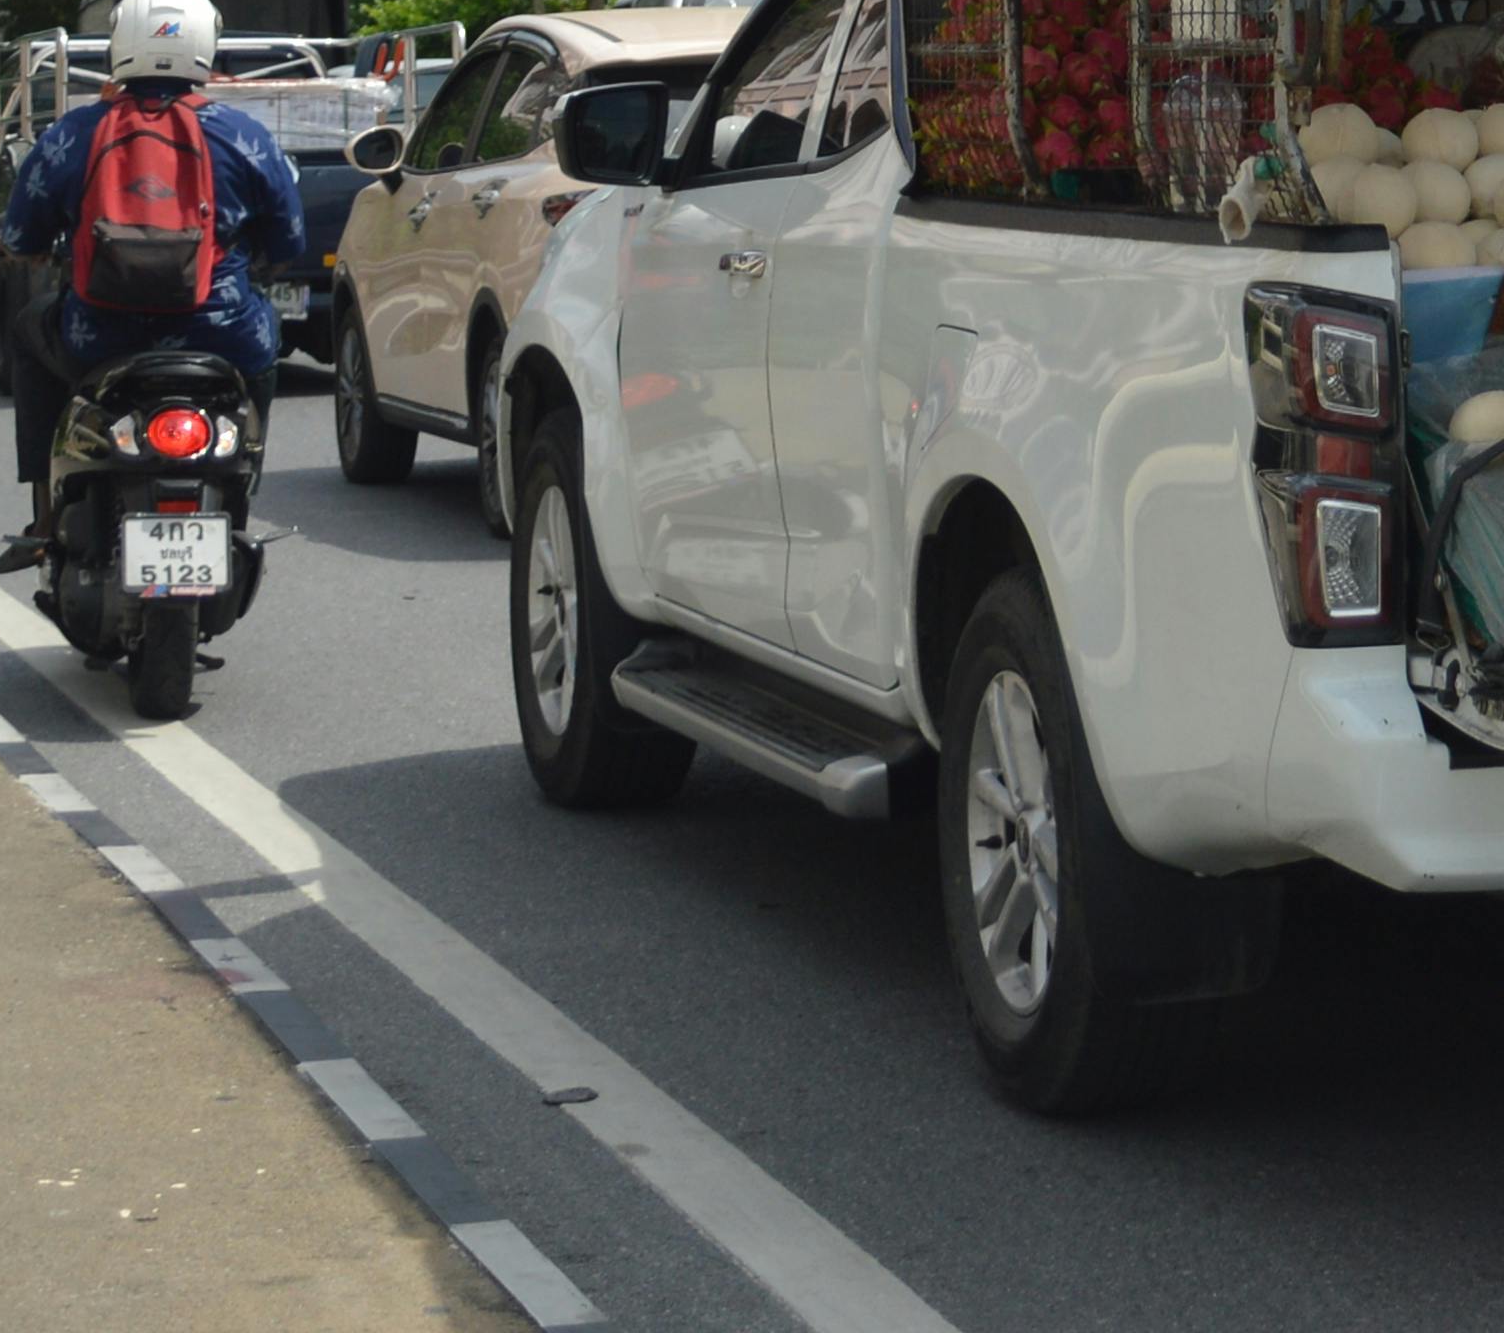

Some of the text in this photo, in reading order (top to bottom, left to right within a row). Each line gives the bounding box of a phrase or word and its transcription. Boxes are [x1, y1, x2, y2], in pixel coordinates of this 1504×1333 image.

[149, 521, 204, 542] 4กว
[160, 545, 193, 562] ชลบุรี
[141, 564, 213, 584] 5123
